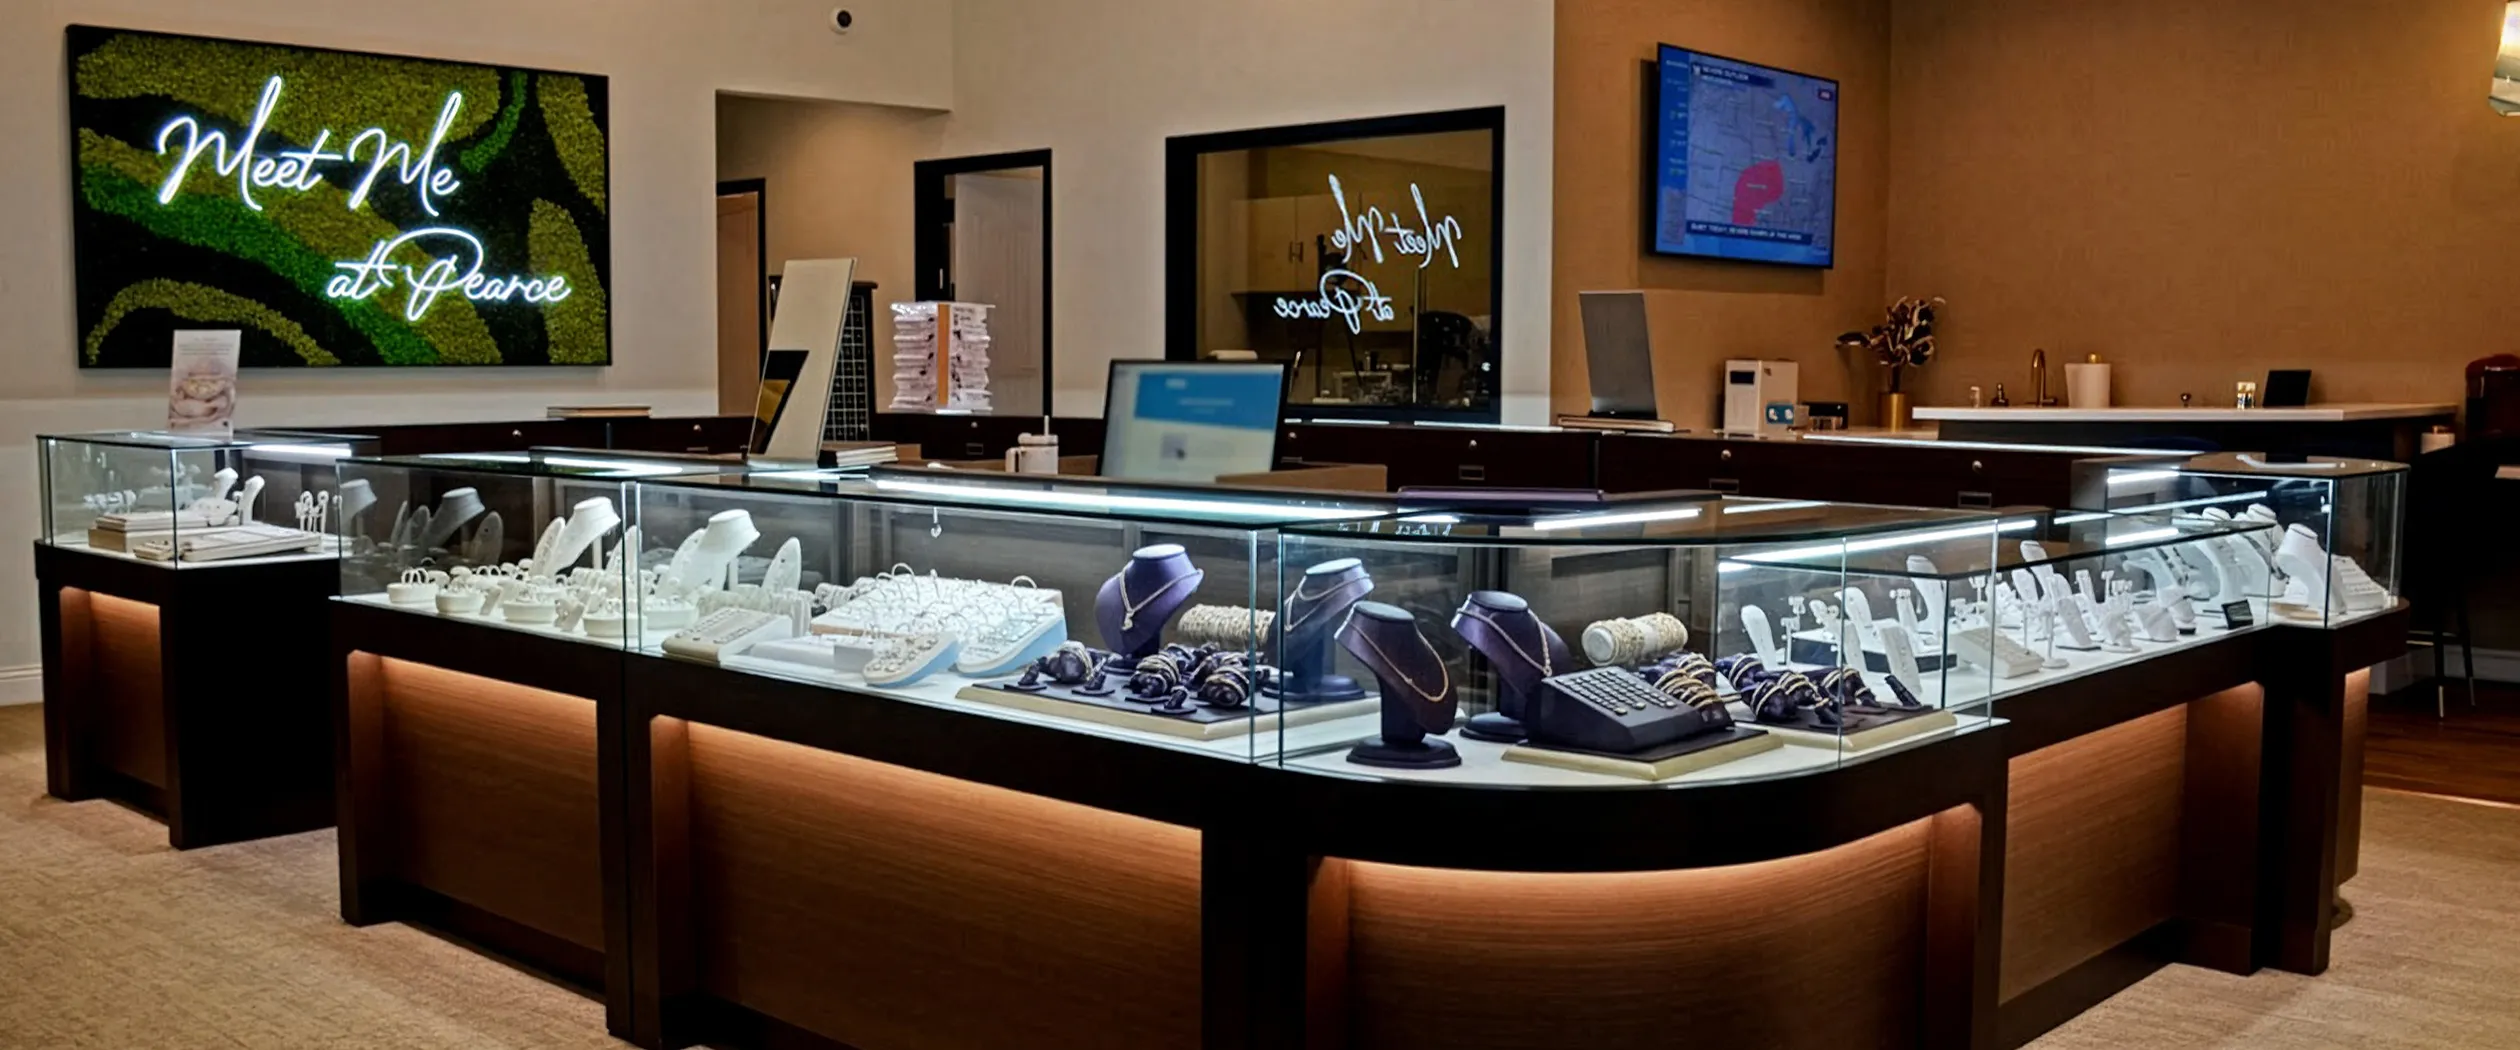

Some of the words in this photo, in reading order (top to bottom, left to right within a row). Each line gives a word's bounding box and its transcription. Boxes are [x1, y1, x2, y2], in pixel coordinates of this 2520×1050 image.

[157, 75, 343, 211] Meet
[347, 91, 462, 217] Me
[326, 240, 398, 300] at
[377, 227, 571, 321] Pearce
